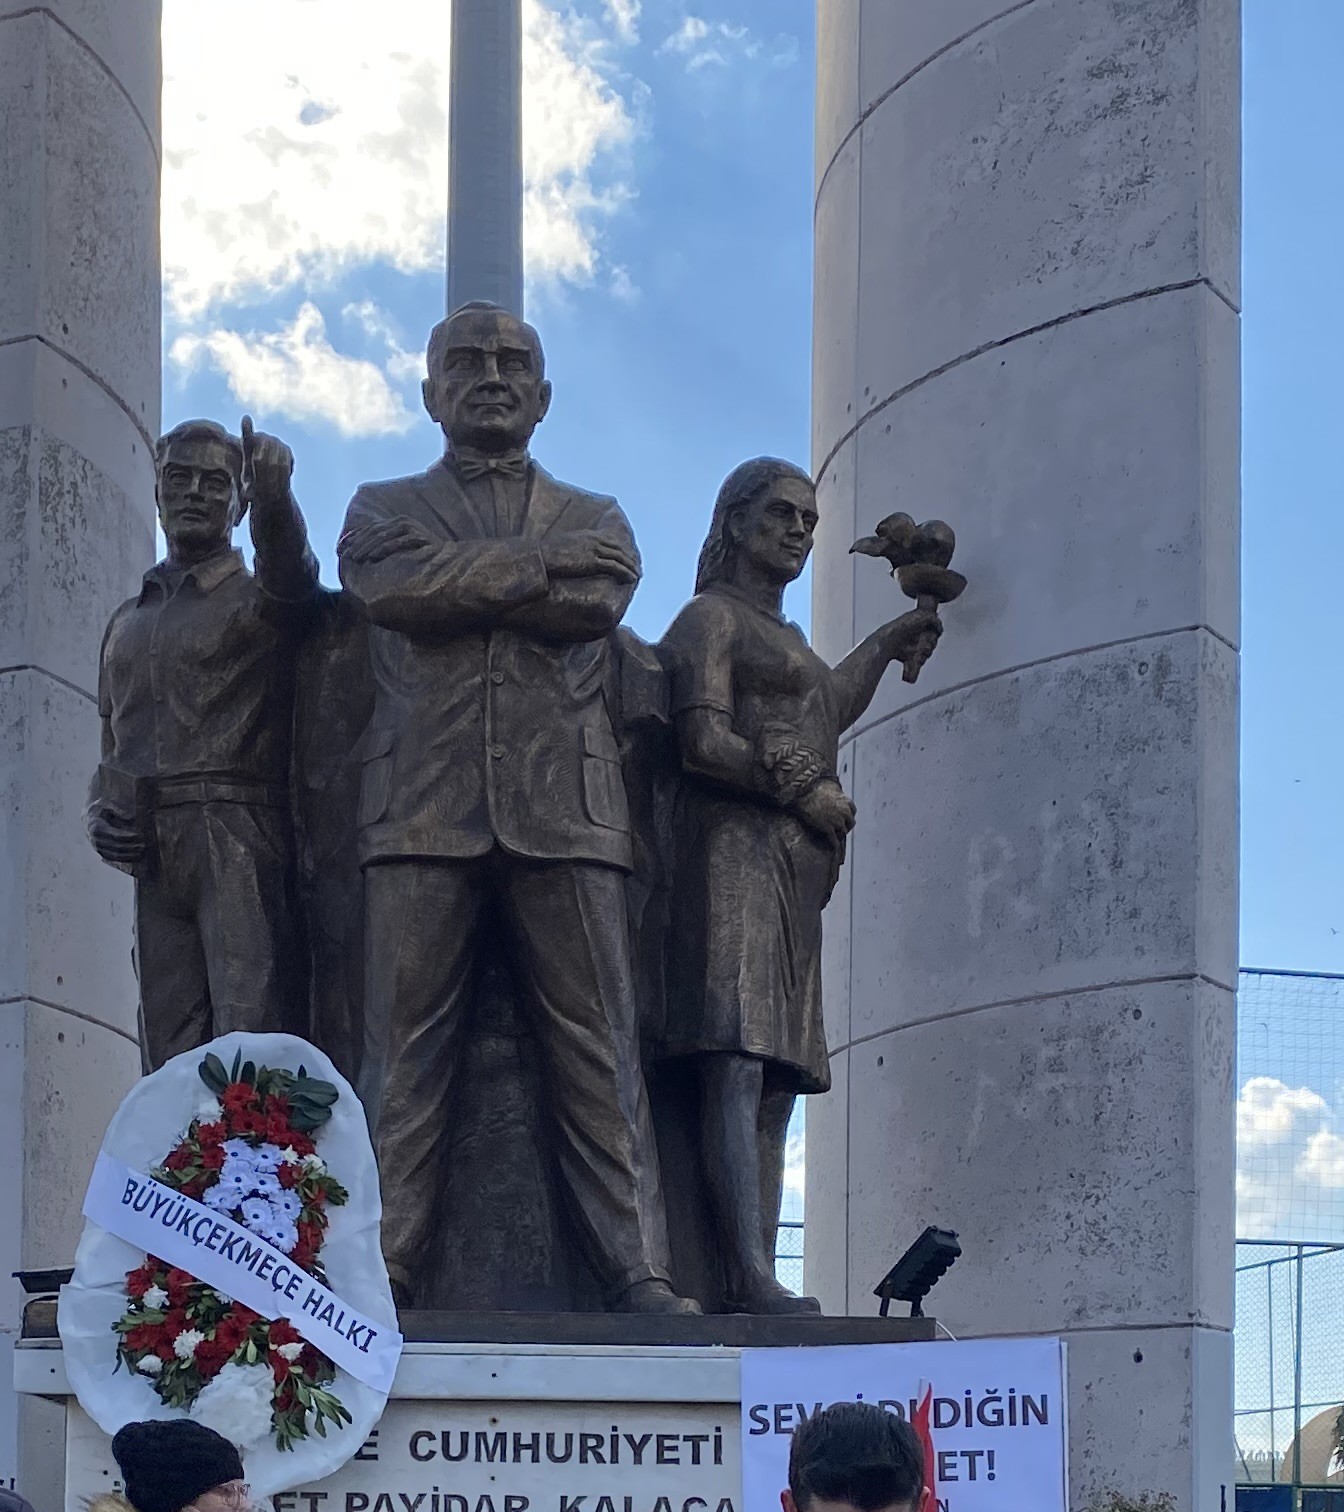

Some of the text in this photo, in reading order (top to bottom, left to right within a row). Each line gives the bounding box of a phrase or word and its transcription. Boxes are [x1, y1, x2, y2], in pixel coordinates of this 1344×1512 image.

[121, 1176, 377, 1354] BÜYÜKÇEKMEÇE HALKI
[409, 1425, 723, 1465] CUMHURİYETİ
